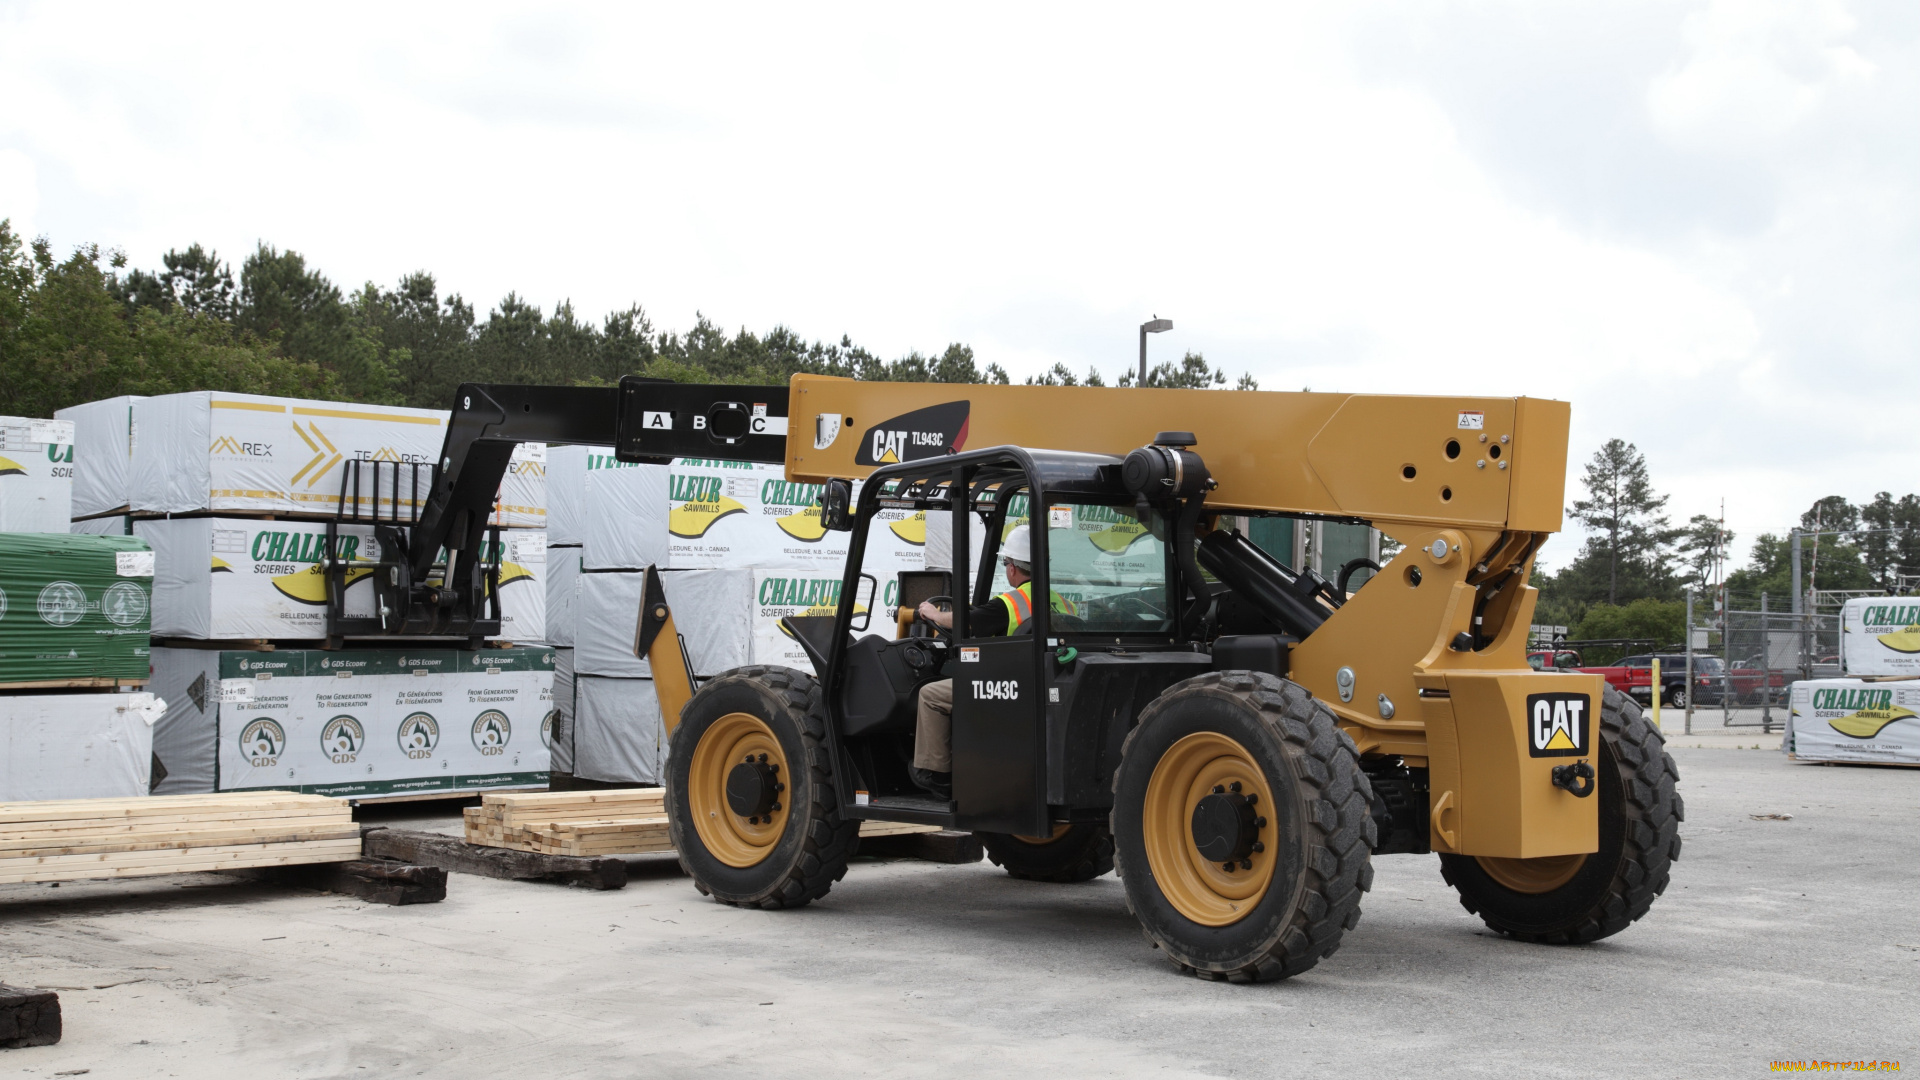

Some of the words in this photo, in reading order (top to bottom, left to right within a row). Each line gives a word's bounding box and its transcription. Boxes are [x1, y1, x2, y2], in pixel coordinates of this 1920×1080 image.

[464, 396, 471, 410] 9
[651, 413, 664, 427] A
[694, 416, 707, 430] B
[752, 418, 766, 432] C
[872, 429, 908, 463] CAT
[911, 431, 943, 446] TL943C
[684, 504, 720, 513] SAWMILLS
[763, 507, 793, 516] SCIERIES
[876, 511, 906, 521] SCIERIES
[1078, 523, 1103, 532] SCIERIES
[1110, 525, 1139, 534] SAWMILLS
[253, 564, 296, 574] SCIERIES
[280, 612, 322, 620] BELLEDUNE,
[760, 608, 795, 617] SCIERIES
[250, 662, 264, 670] GDS
[331, 660, 345, 668] GDS
[467, 688, 482, 696] FROM
[971, 680, 1018, 700] TL943C
[316, 693, 332, 701] FROM
[1812, 688, 1893, 710] CHALEUR
[1855, 711, 1891, 719] SAWMILLS
[1534, 699, 1584, 750] CAT
[408, 749, 432, 760] GDS
[481, 745, 504, 756] GDS
[251, 757, 278, 767] GDS
[331, 754, 357, 764] GDS
